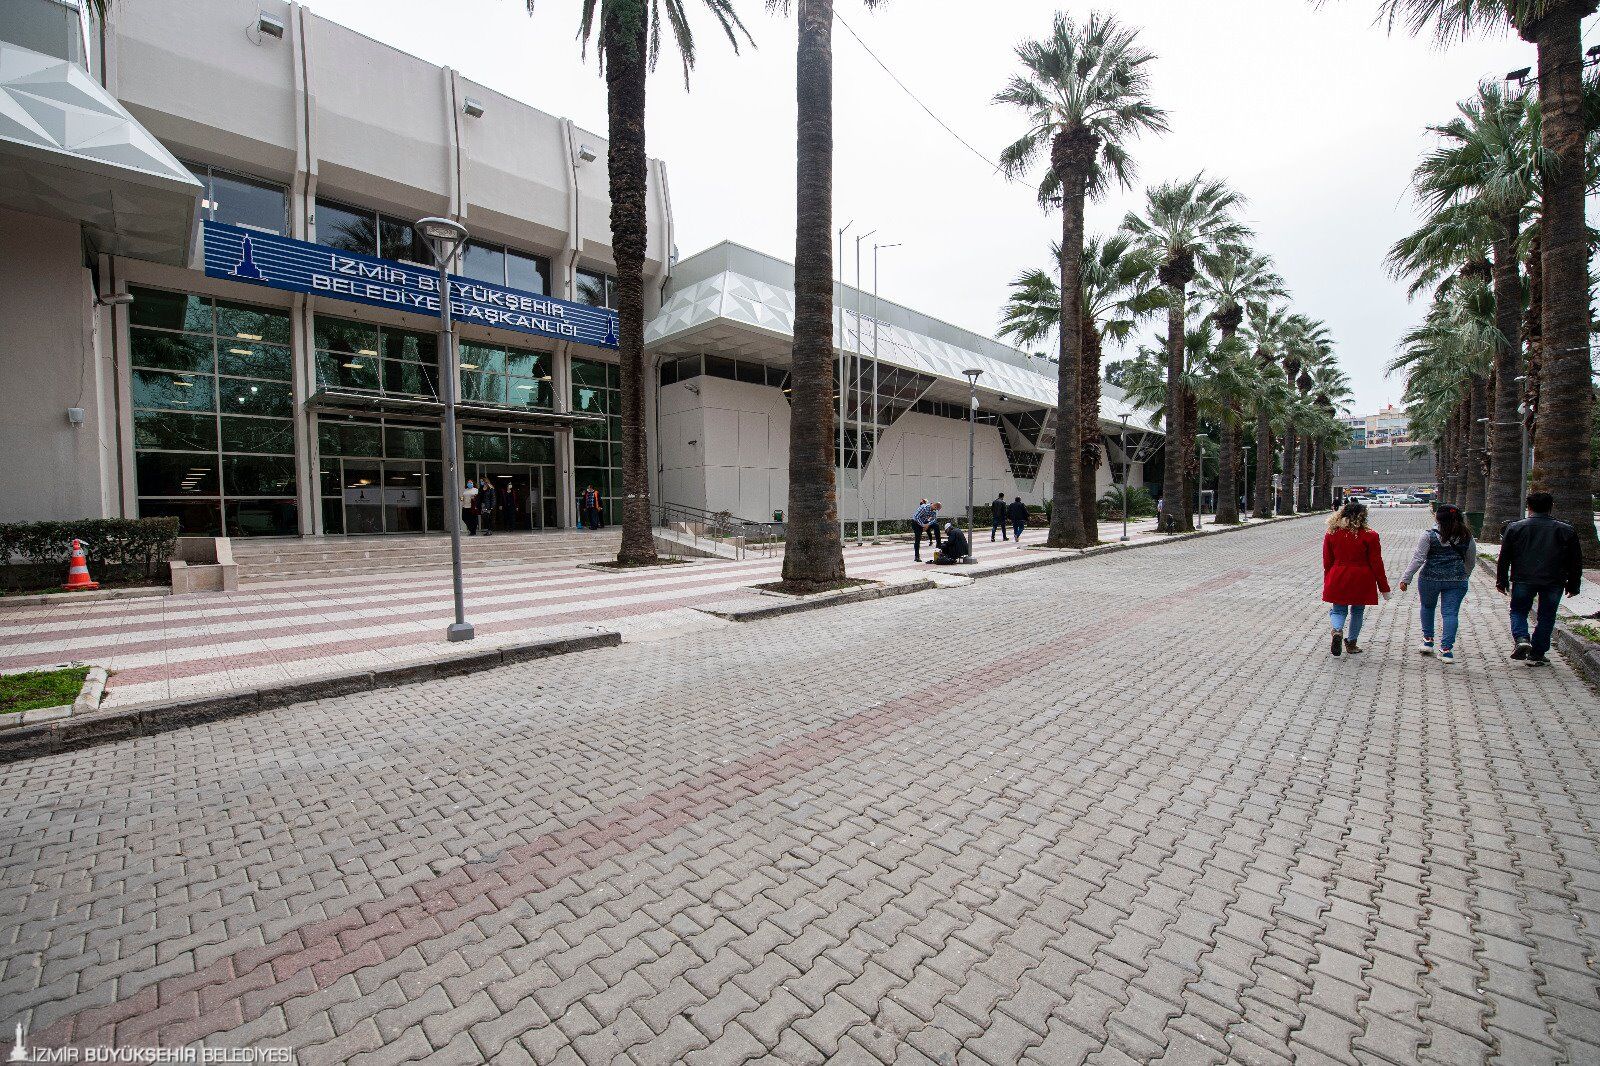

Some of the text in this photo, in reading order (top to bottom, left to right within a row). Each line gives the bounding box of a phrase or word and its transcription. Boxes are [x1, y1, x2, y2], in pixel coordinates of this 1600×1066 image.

[331, 253, 407, 285] İZMİR
[312, 273, 578, 338] BELEDİYE BAŞKANLIĞI
